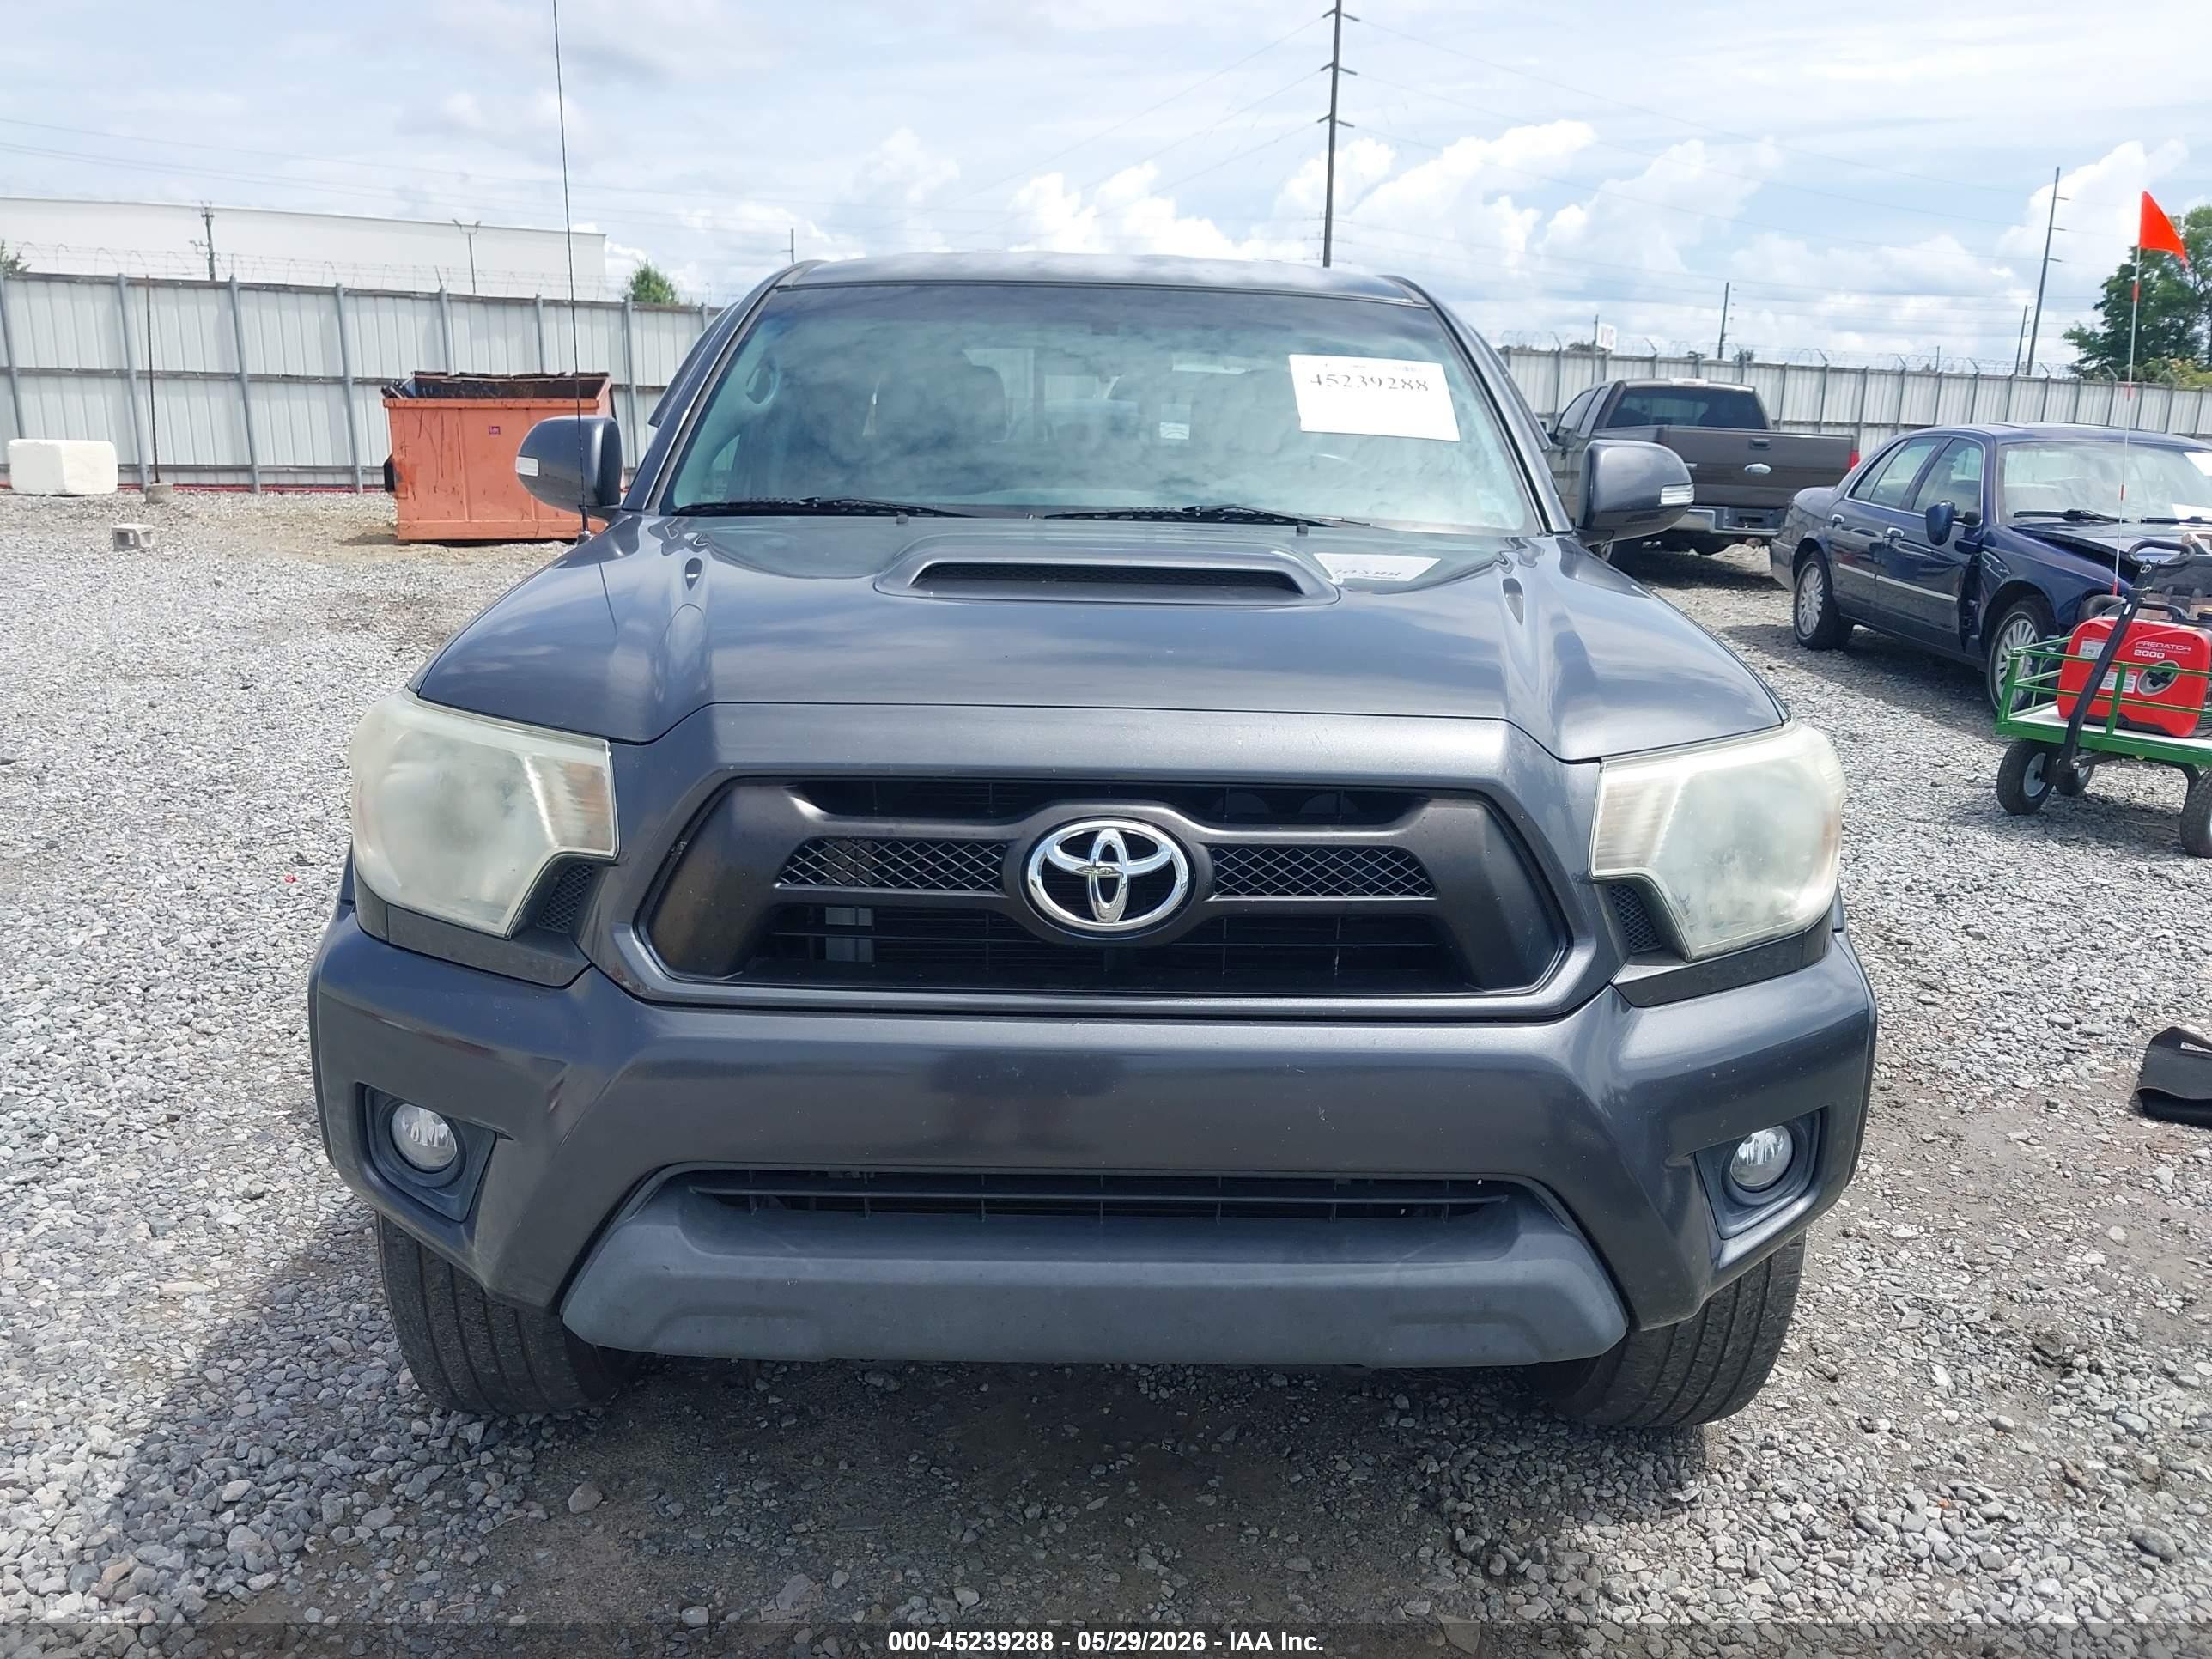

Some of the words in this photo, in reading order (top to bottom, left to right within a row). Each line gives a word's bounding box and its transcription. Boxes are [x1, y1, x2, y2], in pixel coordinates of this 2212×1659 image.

[1310, 374, 1429, 392] 45239288
[2136, 640, 2191, 652] PREDATOR
[2134, 649, 2165, 659] 2000
